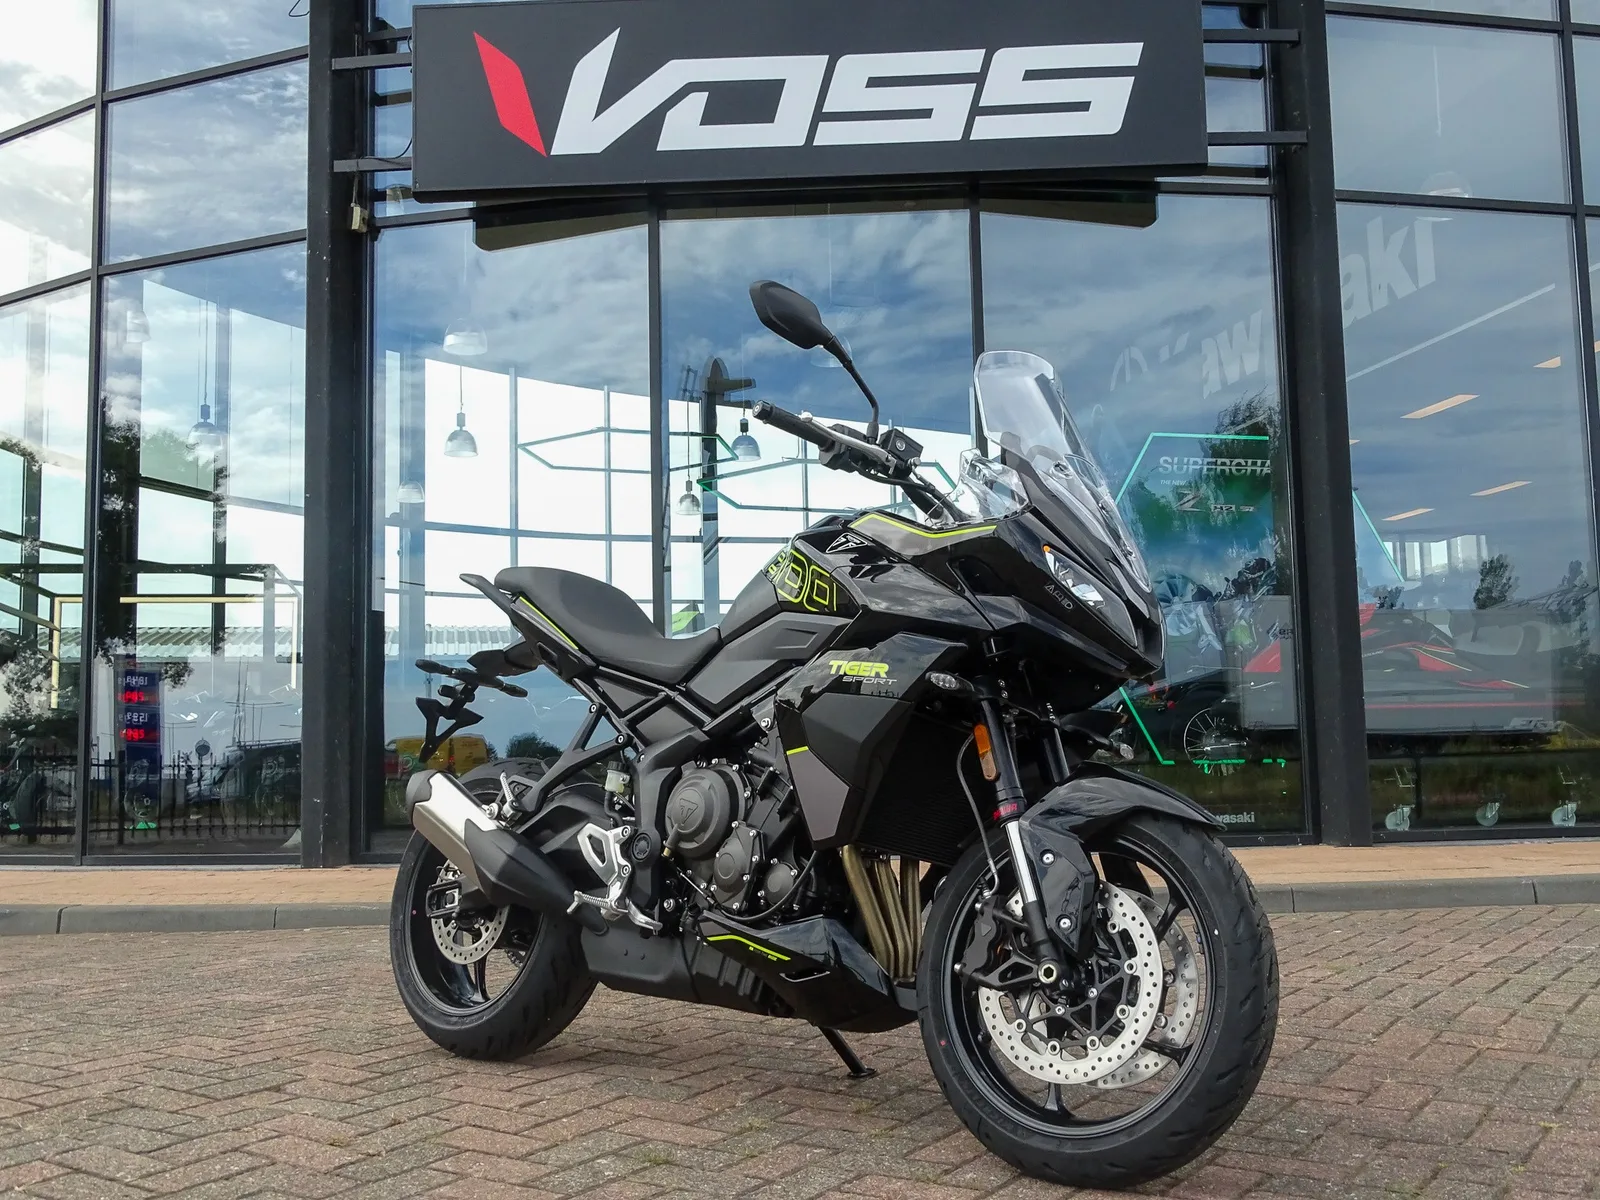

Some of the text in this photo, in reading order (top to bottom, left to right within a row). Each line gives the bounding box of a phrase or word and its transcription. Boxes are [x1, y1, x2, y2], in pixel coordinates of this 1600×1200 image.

[550, 27, 1144, 155] VOSS
[829, 660, 889, 678] TIGER
[842, 675, 898, 685] SPORT
